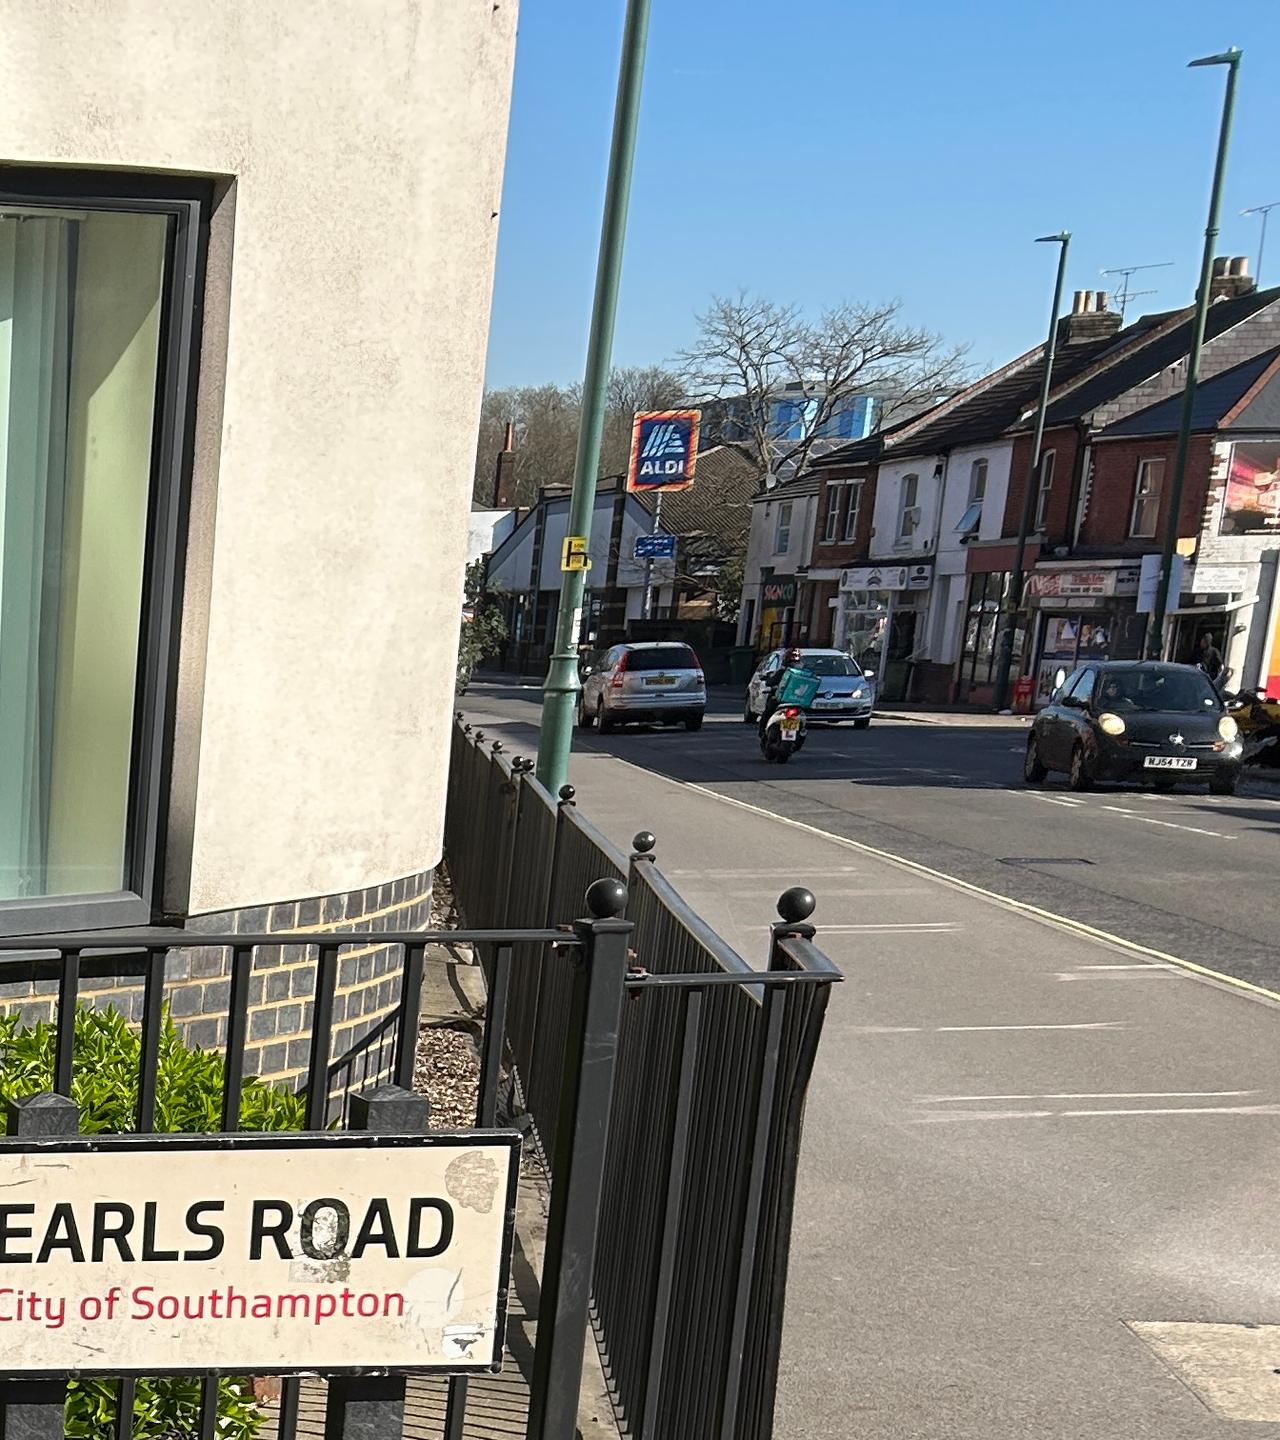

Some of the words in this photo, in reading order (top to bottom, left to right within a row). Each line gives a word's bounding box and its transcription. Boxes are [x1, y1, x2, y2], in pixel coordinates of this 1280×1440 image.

[640, 459, 685, 475] ALDI
[249, 1197, 455, 1260] ROAD
[79, 1287, 121, 1320] of
[131, 1285, 405, 1326] Southampton
